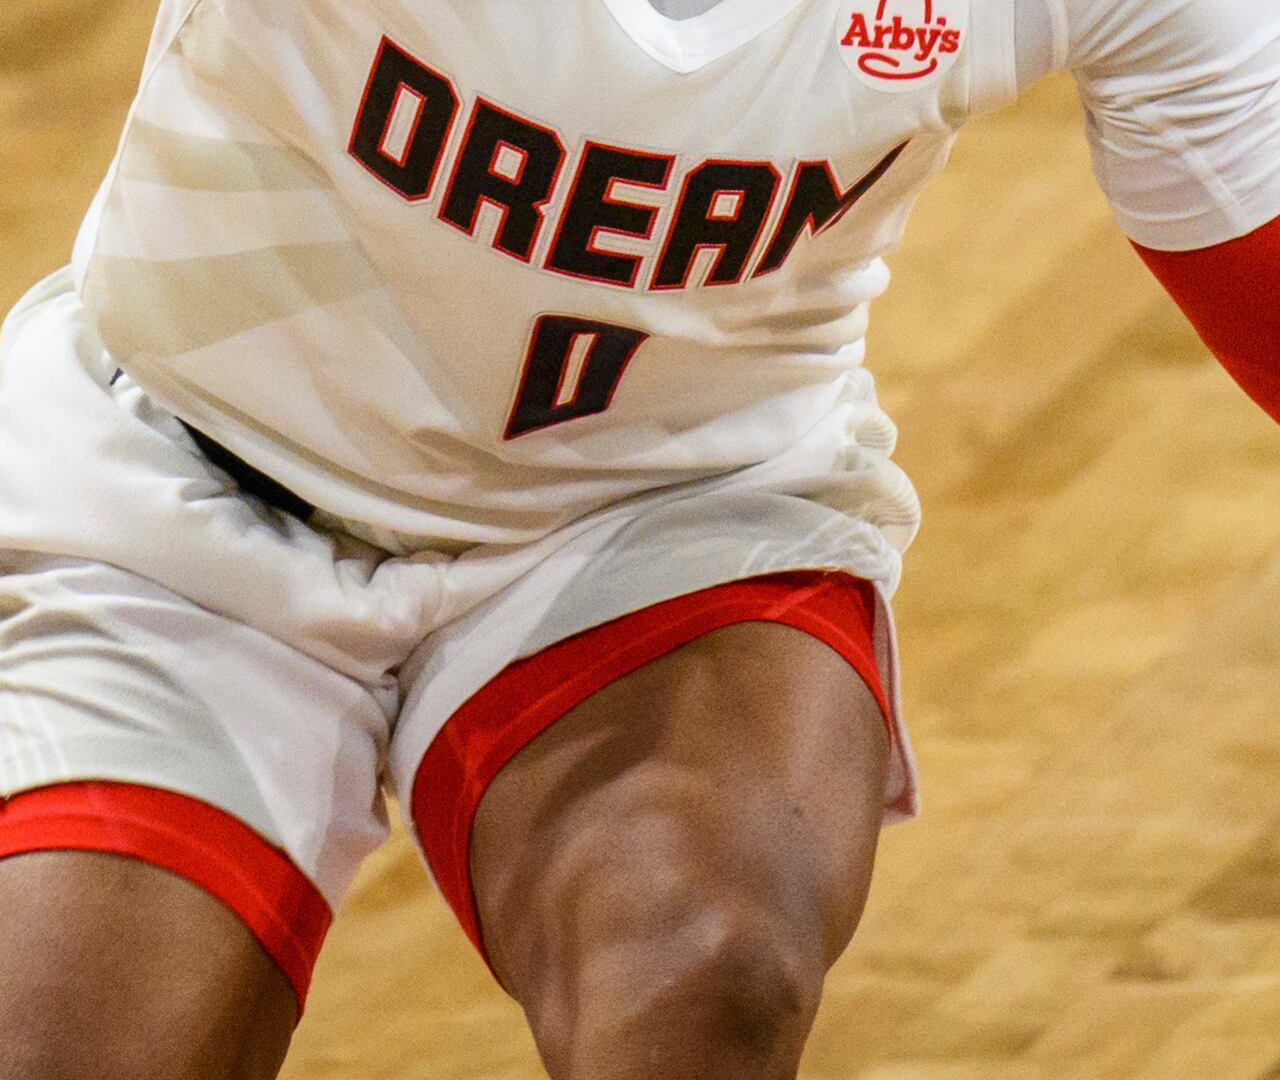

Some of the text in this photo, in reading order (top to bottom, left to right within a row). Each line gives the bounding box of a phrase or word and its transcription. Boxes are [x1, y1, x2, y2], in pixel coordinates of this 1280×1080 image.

[840, 12, 961, 61] Arby's
[347, 34, 912, 291] DREAM
[503, 313, 651, 442] 0
